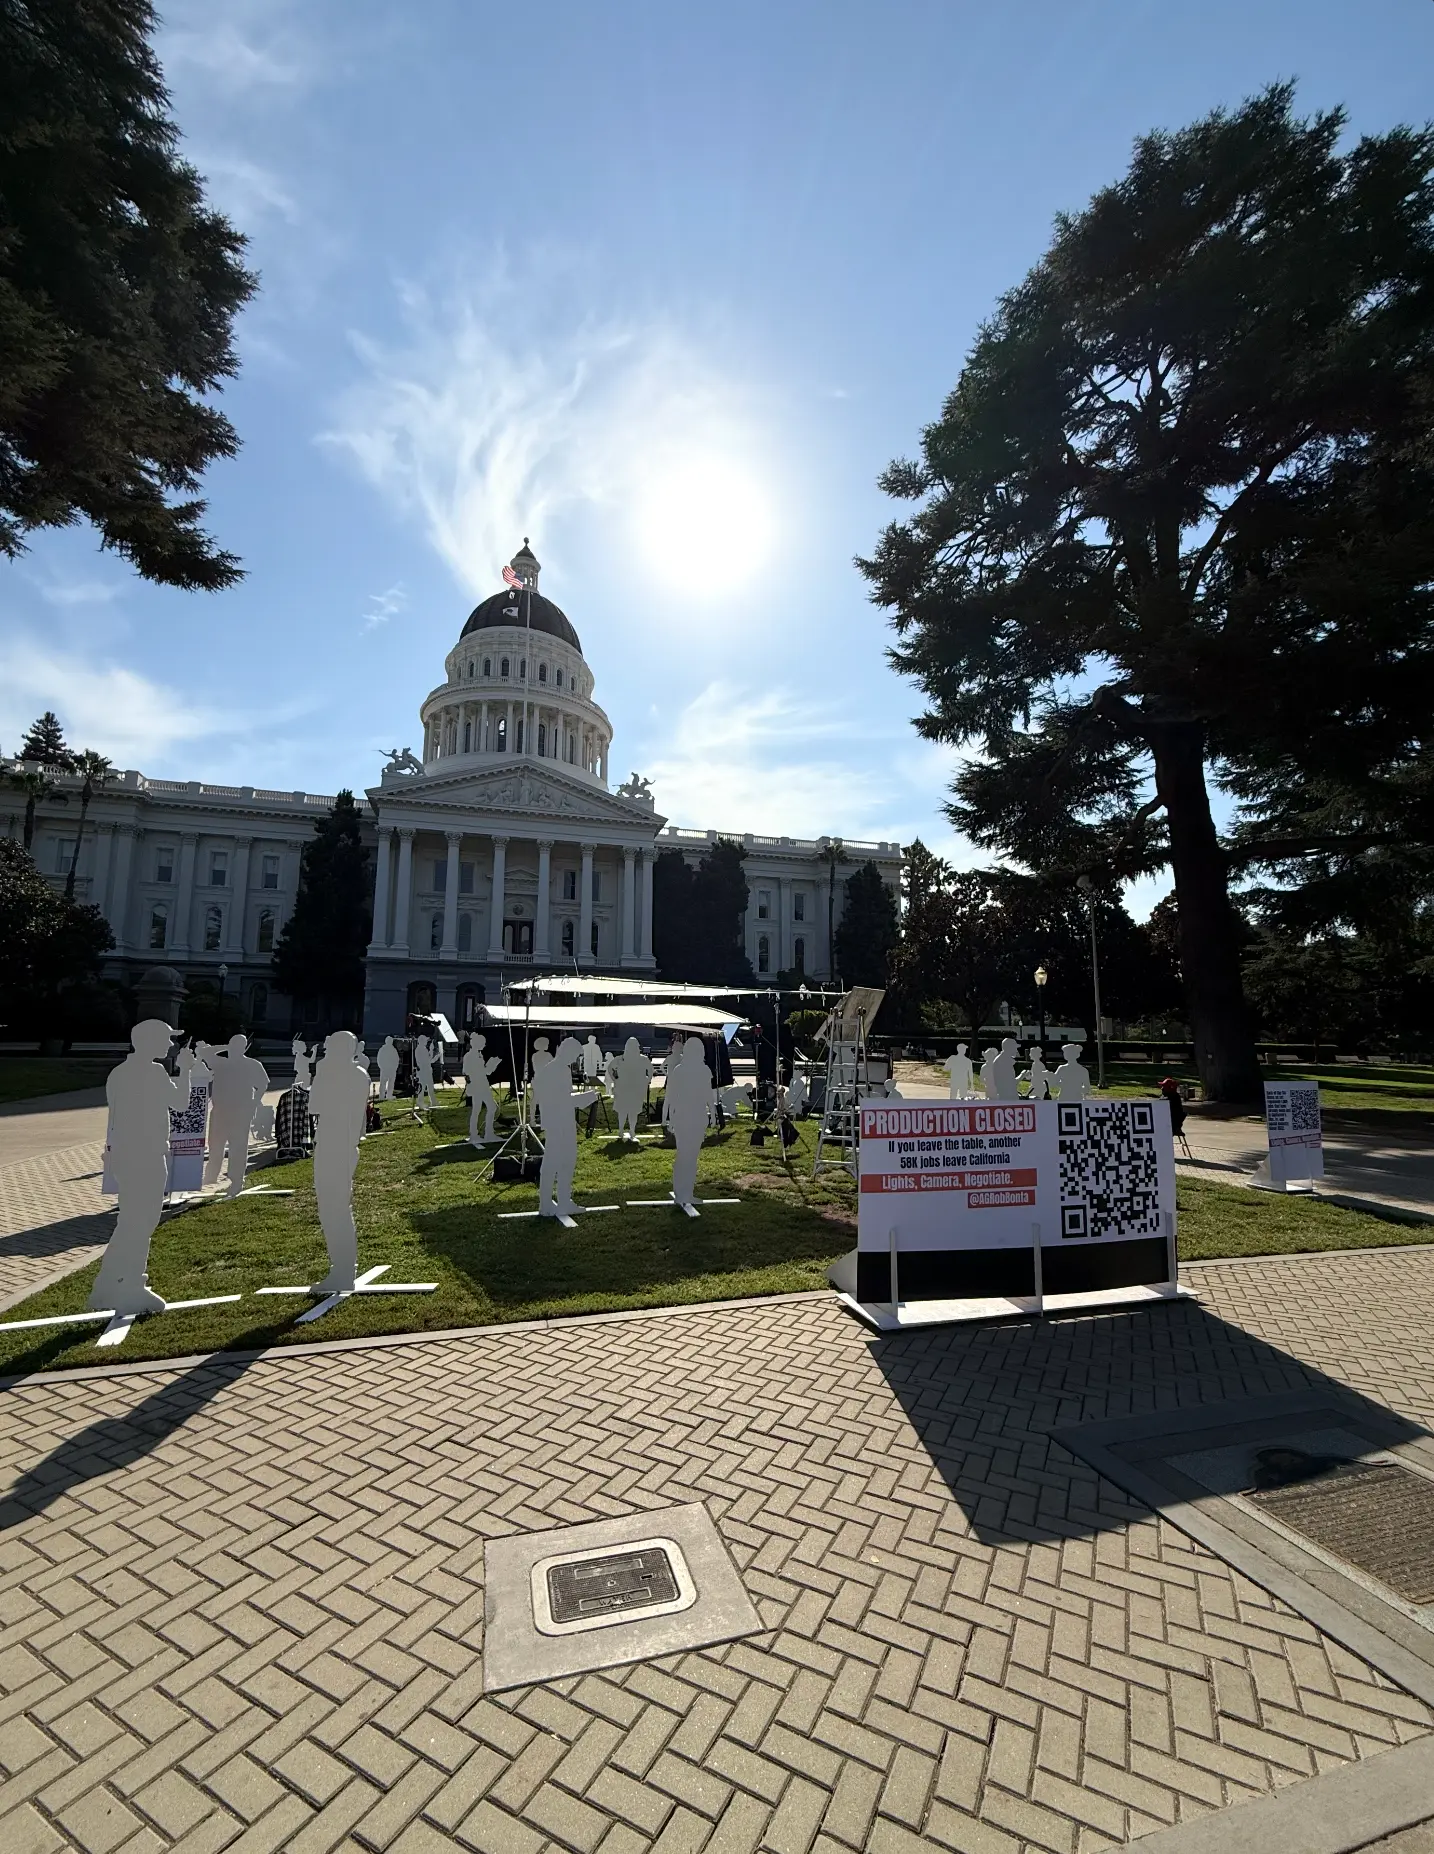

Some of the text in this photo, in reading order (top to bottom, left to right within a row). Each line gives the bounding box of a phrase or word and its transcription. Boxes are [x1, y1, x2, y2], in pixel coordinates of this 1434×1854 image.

[864, 1107, 1034, 1135] PRODUCTION CLOSED
[888, 1136, 1022, 1154] If you leave the table, another
[900, 1152, 1011, 1170] 58K jobs leave California
[882, 1171, 1014, 1190] Lights, Camera, Negotiate.
[969, 1192, 1029, 1206] @AGRobBonta
